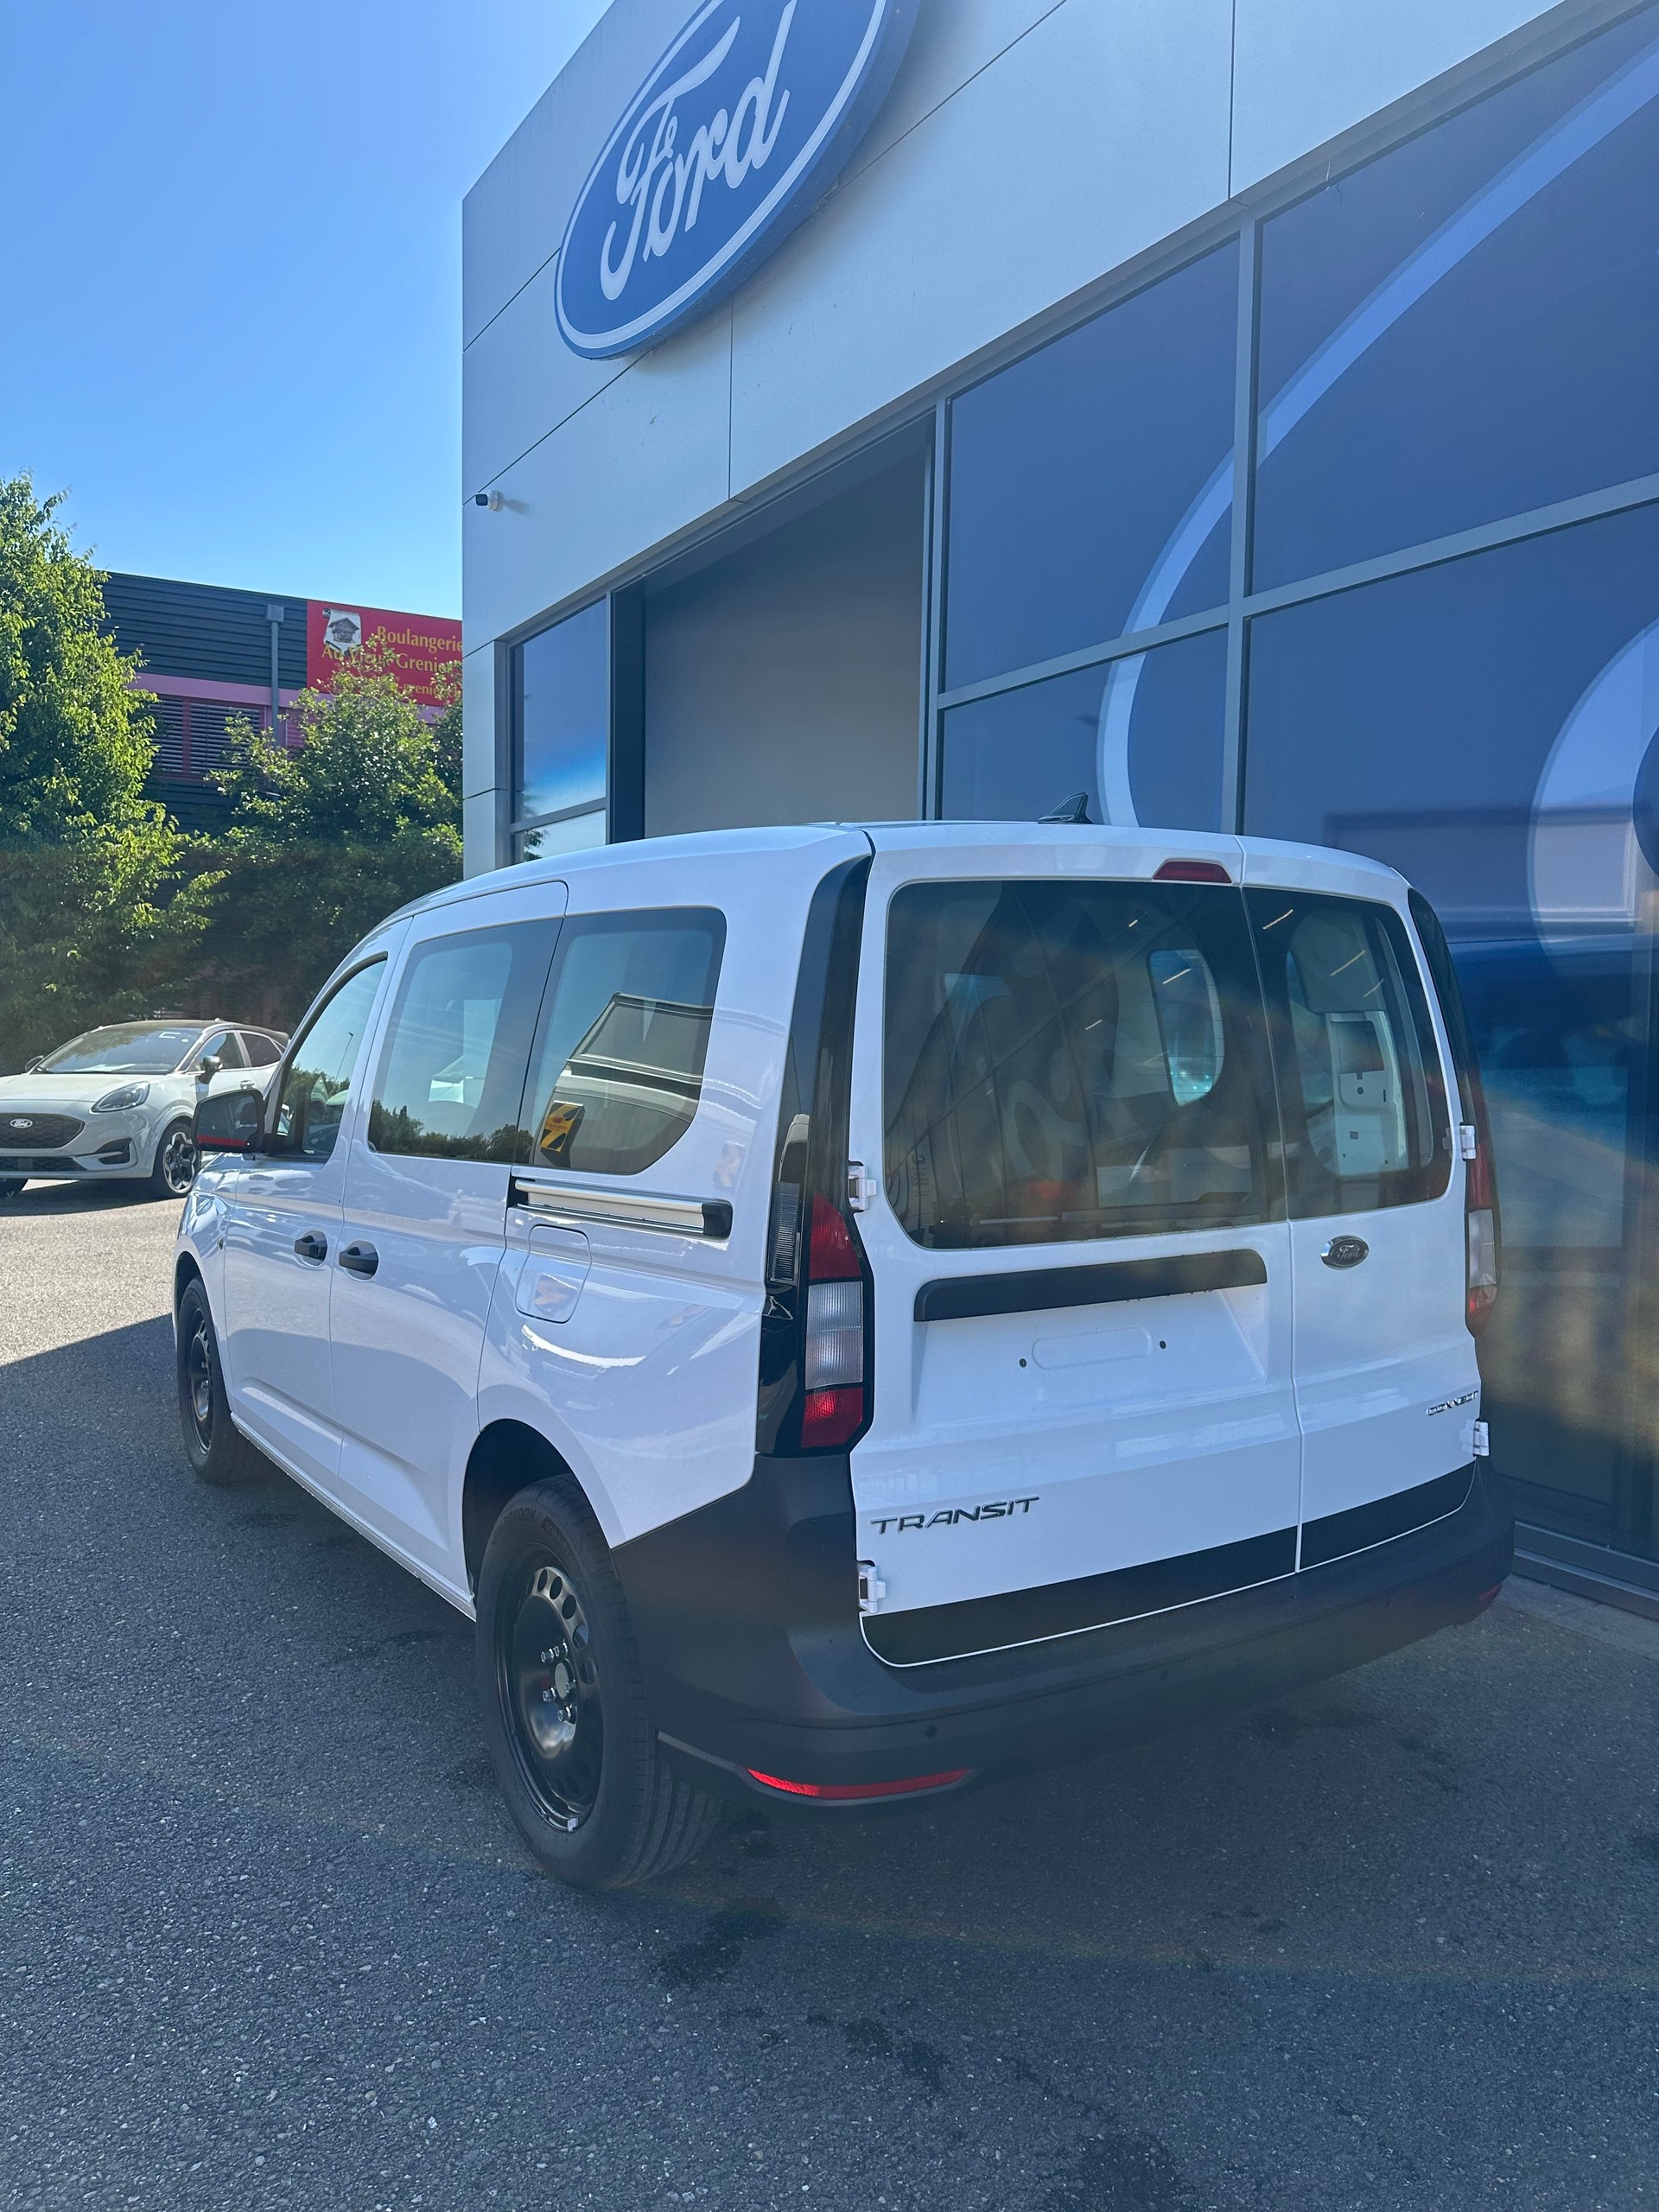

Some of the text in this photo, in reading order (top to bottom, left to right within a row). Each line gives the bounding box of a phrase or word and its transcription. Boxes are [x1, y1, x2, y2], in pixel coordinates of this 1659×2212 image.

[601, 0, 797, 300] Ford
[321, 643, 344, 661] Au
[377, 626, 462, 654] Boulangerie
[1337, 1244, 1360, 1259] Ford
[870, 1496, 1040, 1535] TRANSIT
